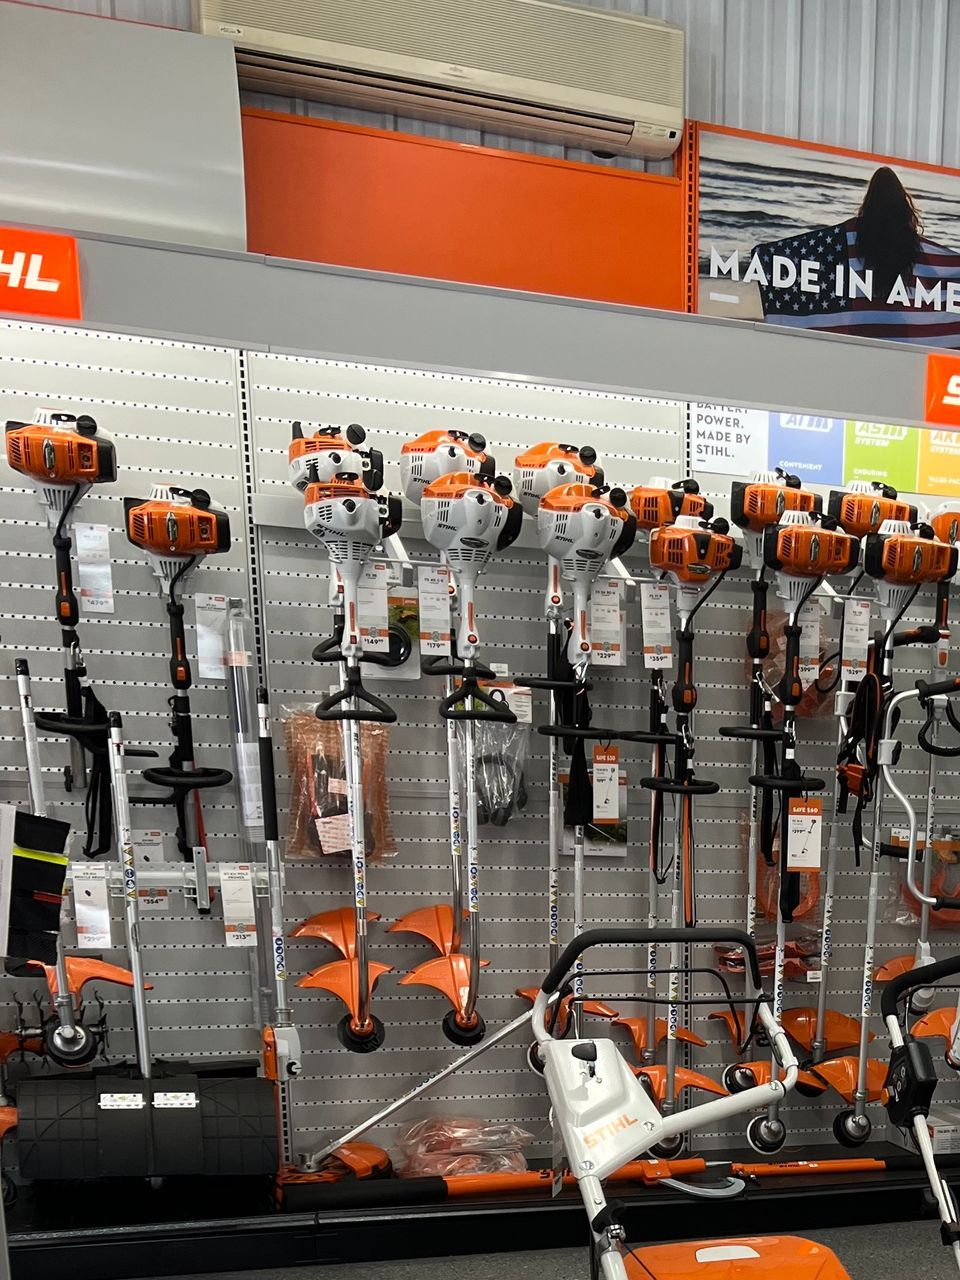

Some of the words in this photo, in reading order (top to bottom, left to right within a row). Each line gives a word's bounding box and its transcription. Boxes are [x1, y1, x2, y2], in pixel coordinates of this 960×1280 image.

[709, 245, 821, 294] MADE
[835, 264, 873, 301] IN
[696, 413, 744, 429] POWER.
[696, 429, 731, 443] MADE
[736, 432, 751, 444] BY
[854, 437, 890, 448] SYSTEM
[696, 444, 735, 458] STIHL.
[778, 459, 823, 471] CONVENIENT
[315, 523, 348, 538] STIHL
[436, 522, 459, 532] STIHL
[554, 535, 575, 544] STIHL
[583, 1113, 639, 1149] STIHL
